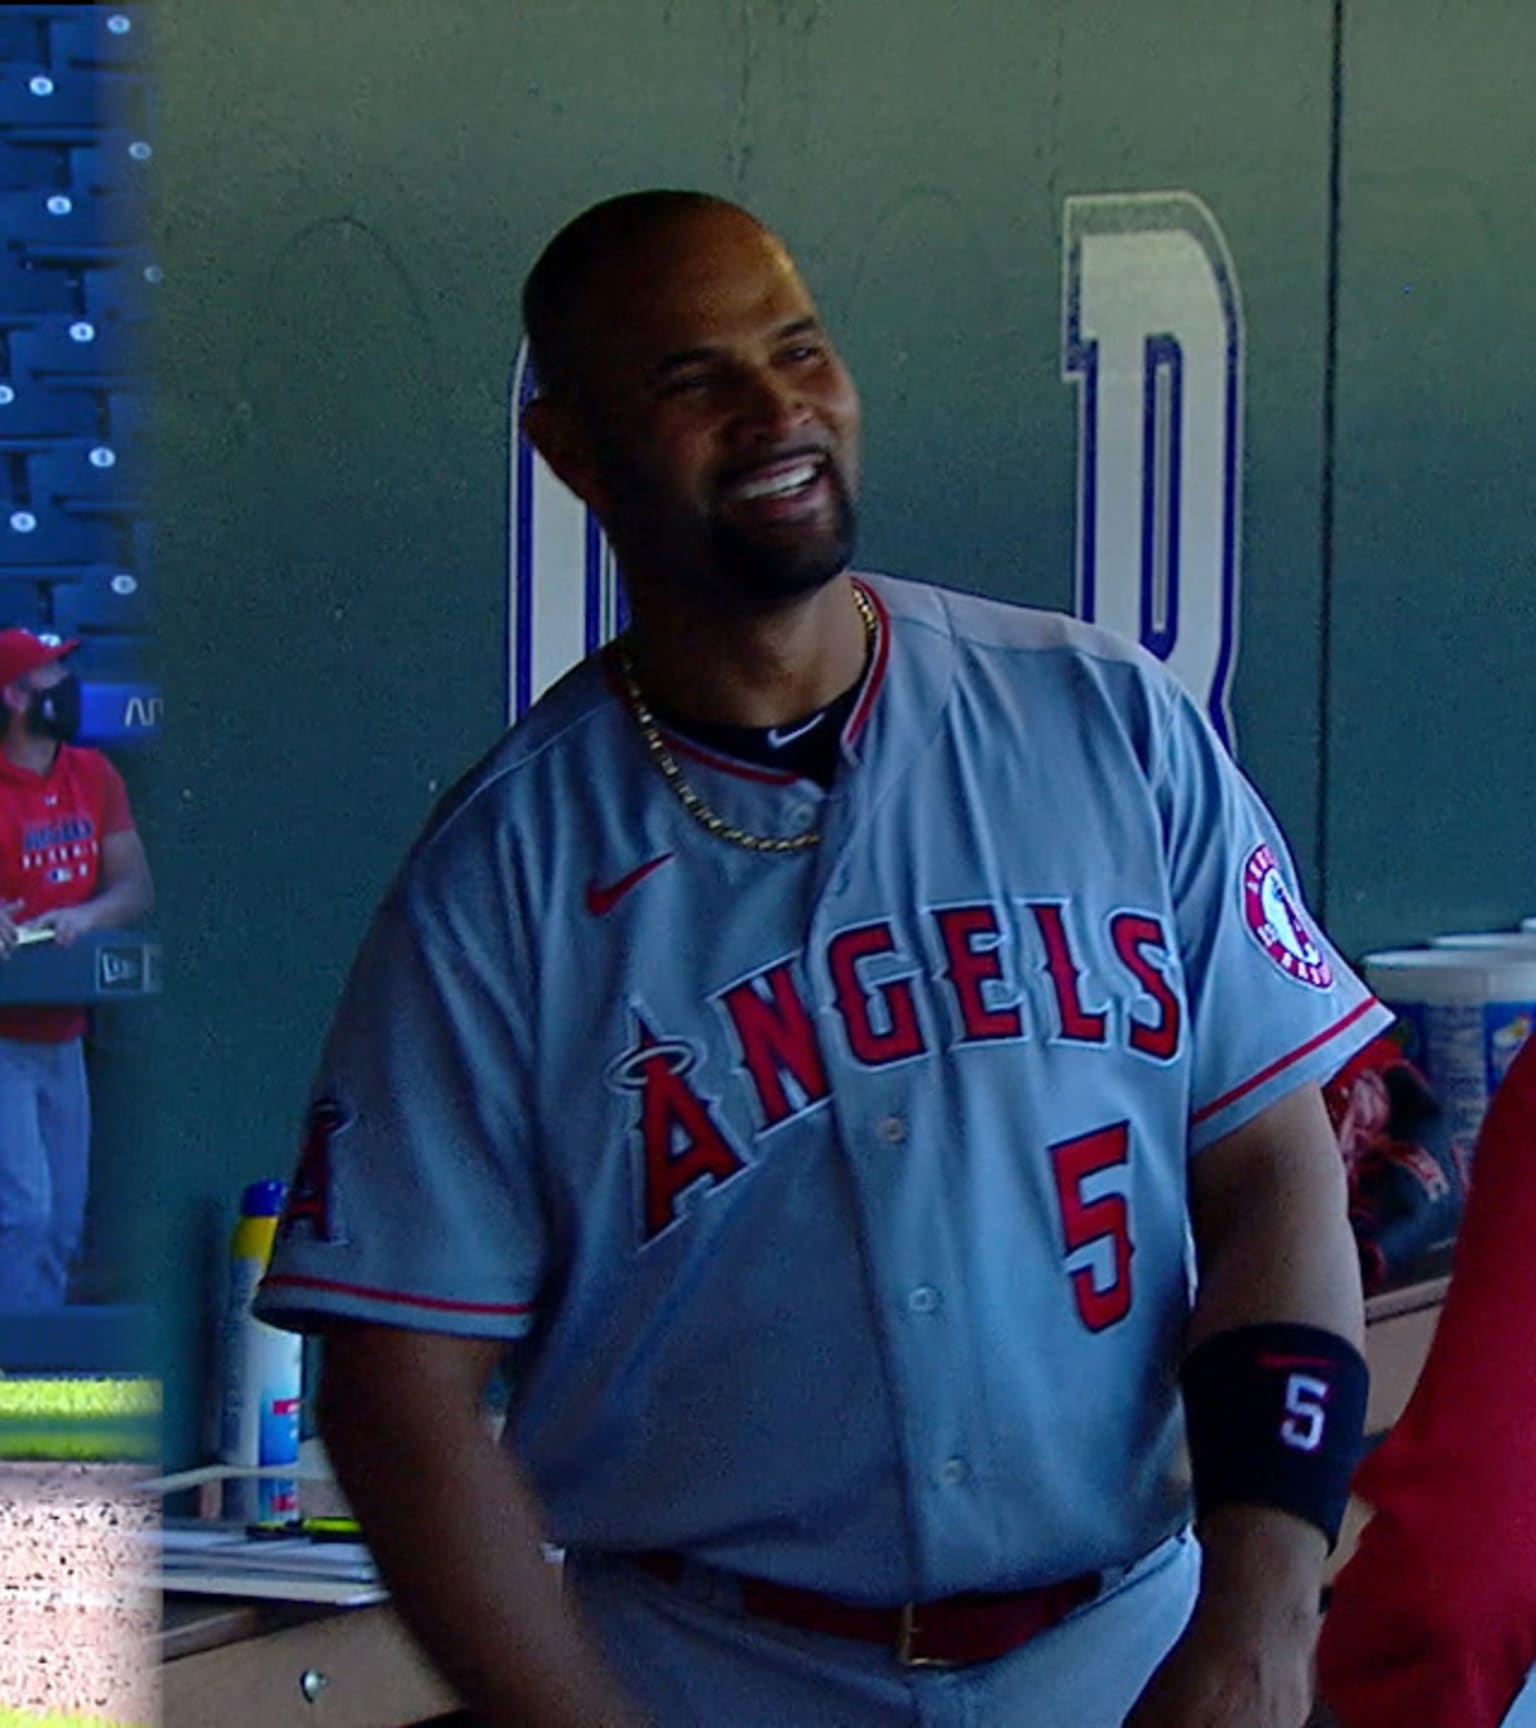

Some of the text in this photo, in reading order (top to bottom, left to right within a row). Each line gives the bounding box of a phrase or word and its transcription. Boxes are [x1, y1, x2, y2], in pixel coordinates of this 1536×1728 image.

[606, 900, 1188, 1254] ANGELS
[1048, 1119, 1136, 1334] 5
[1280, 1373, 1328, 1451] 5
